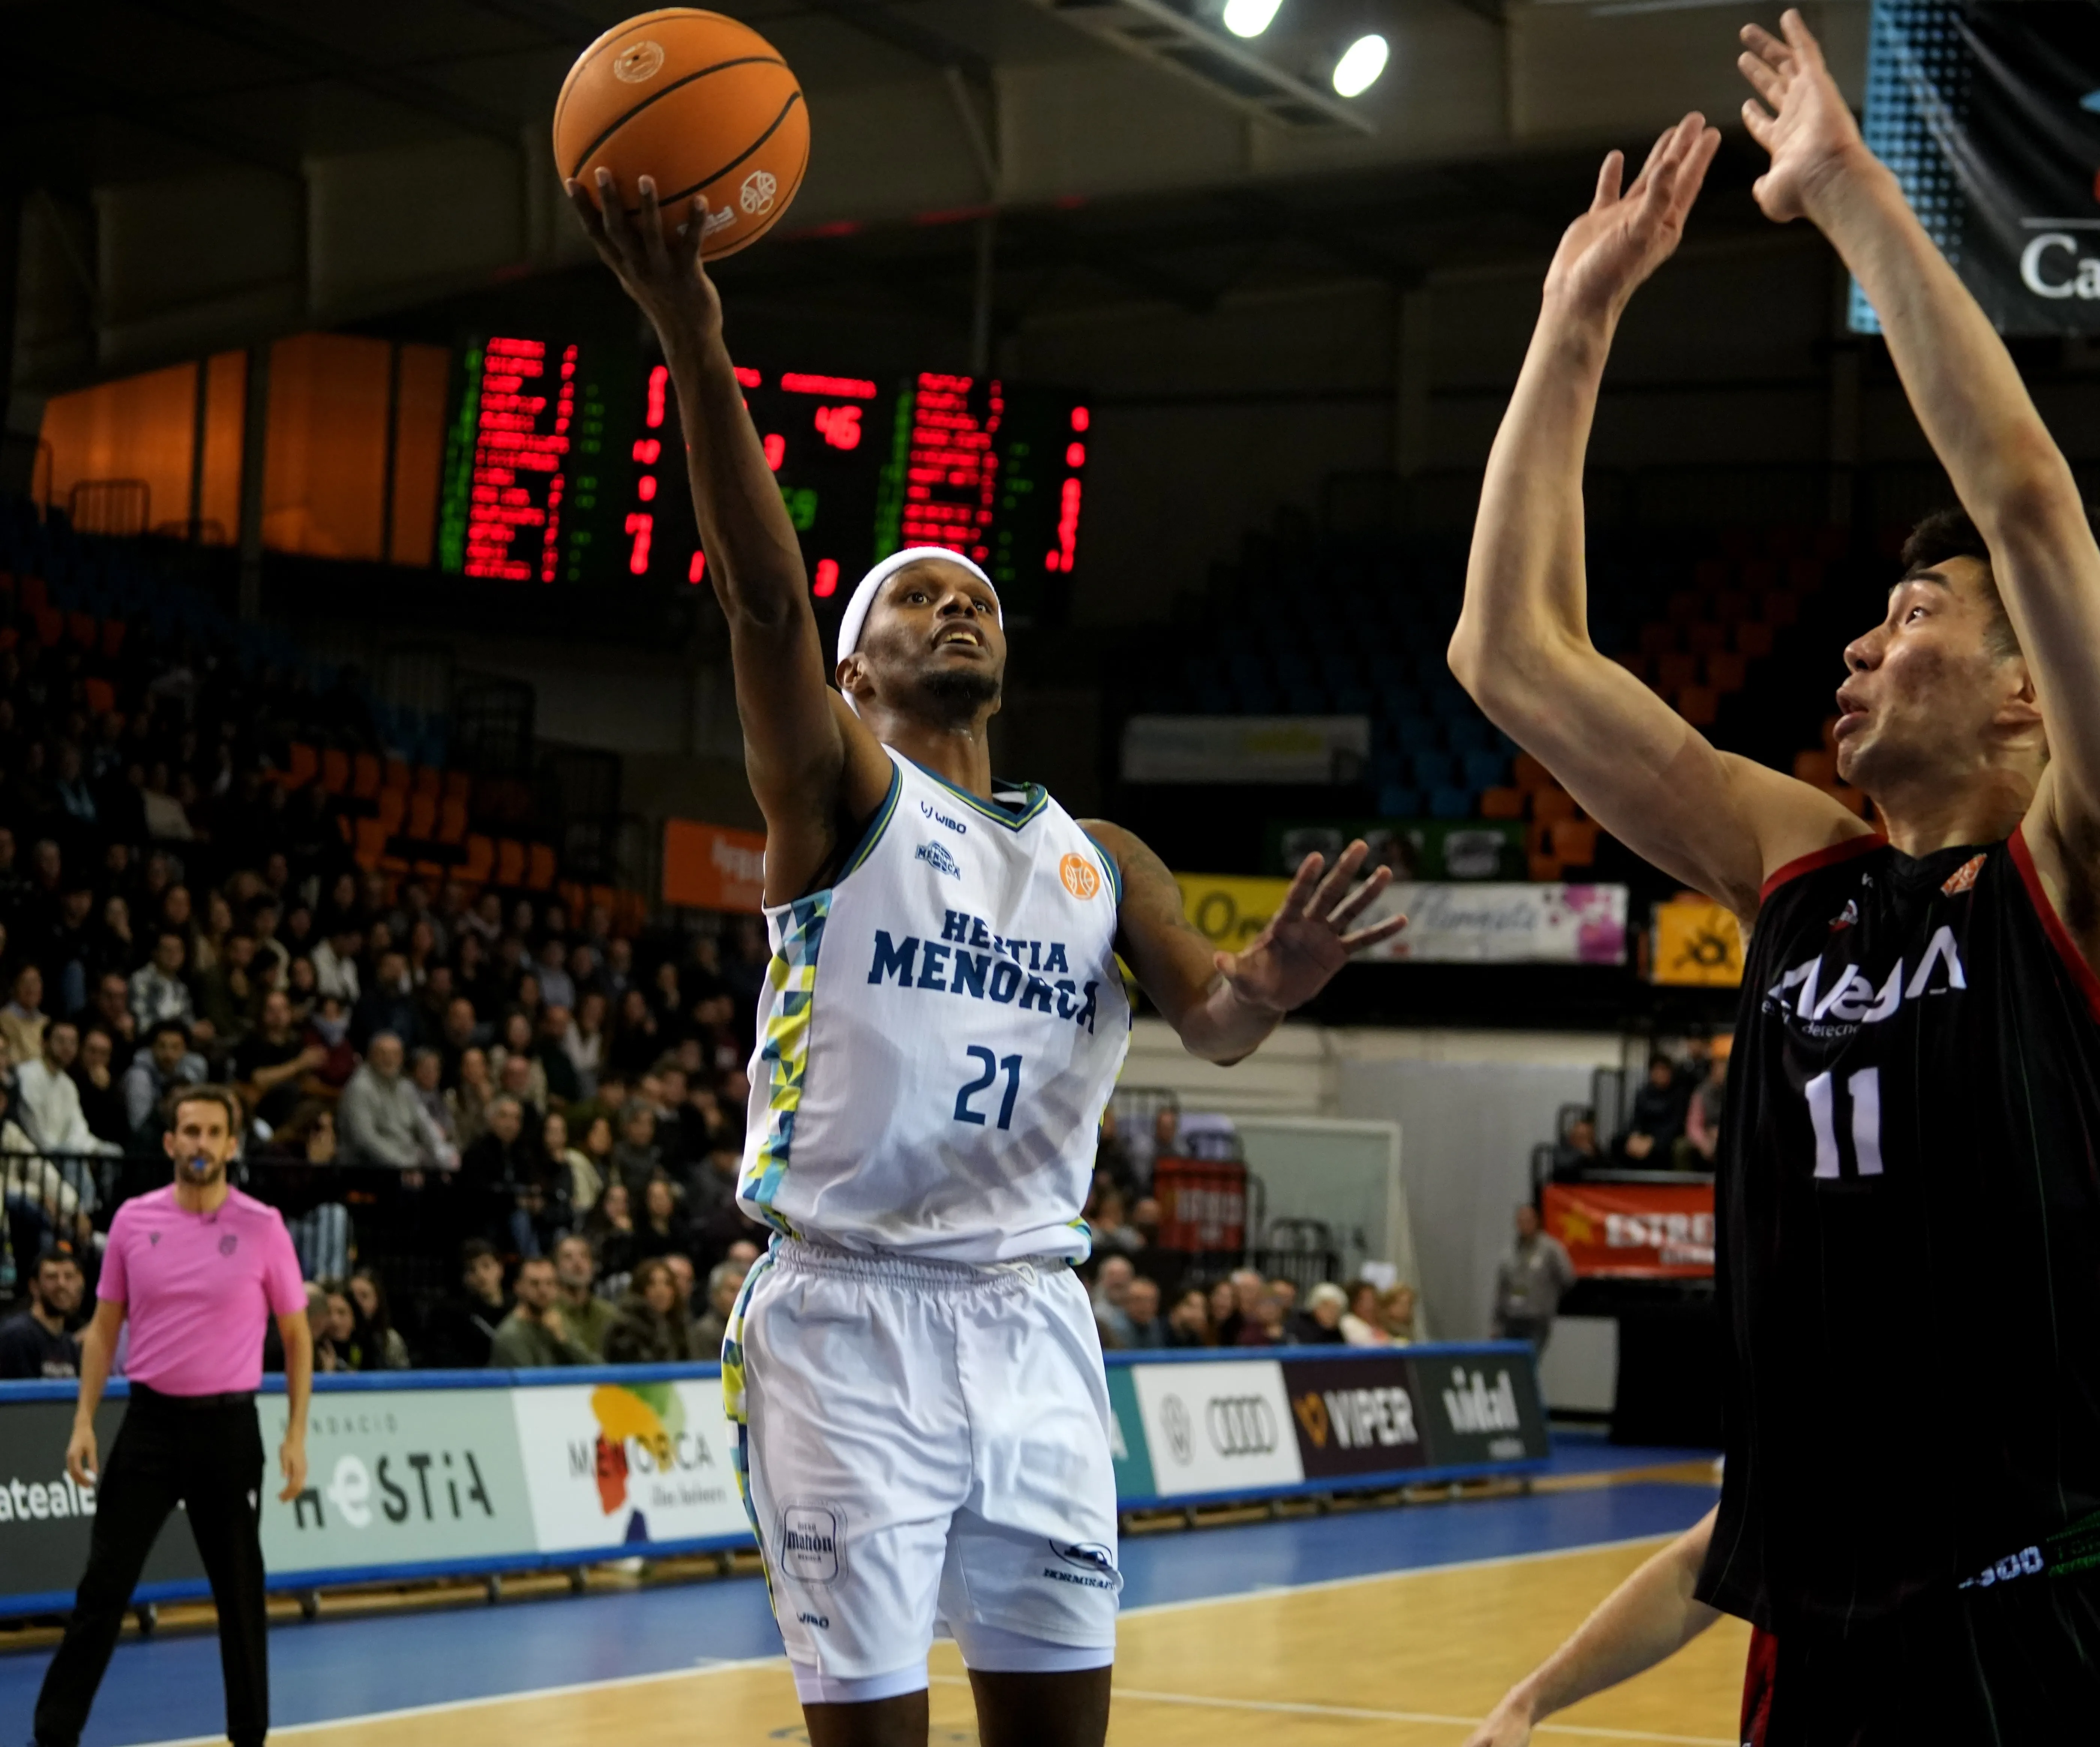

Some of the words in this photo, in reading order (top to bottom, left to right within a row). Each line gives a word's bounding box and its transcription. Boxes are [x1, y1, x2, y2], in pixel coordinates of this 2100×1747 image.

[868, 930, 1100, 1035] MENORCA
[953, 1045, 1023, 1131] 21
[1805, 1067, 1884, 1178] 11
[1322, 1386, 1419, 1448] VIPER
